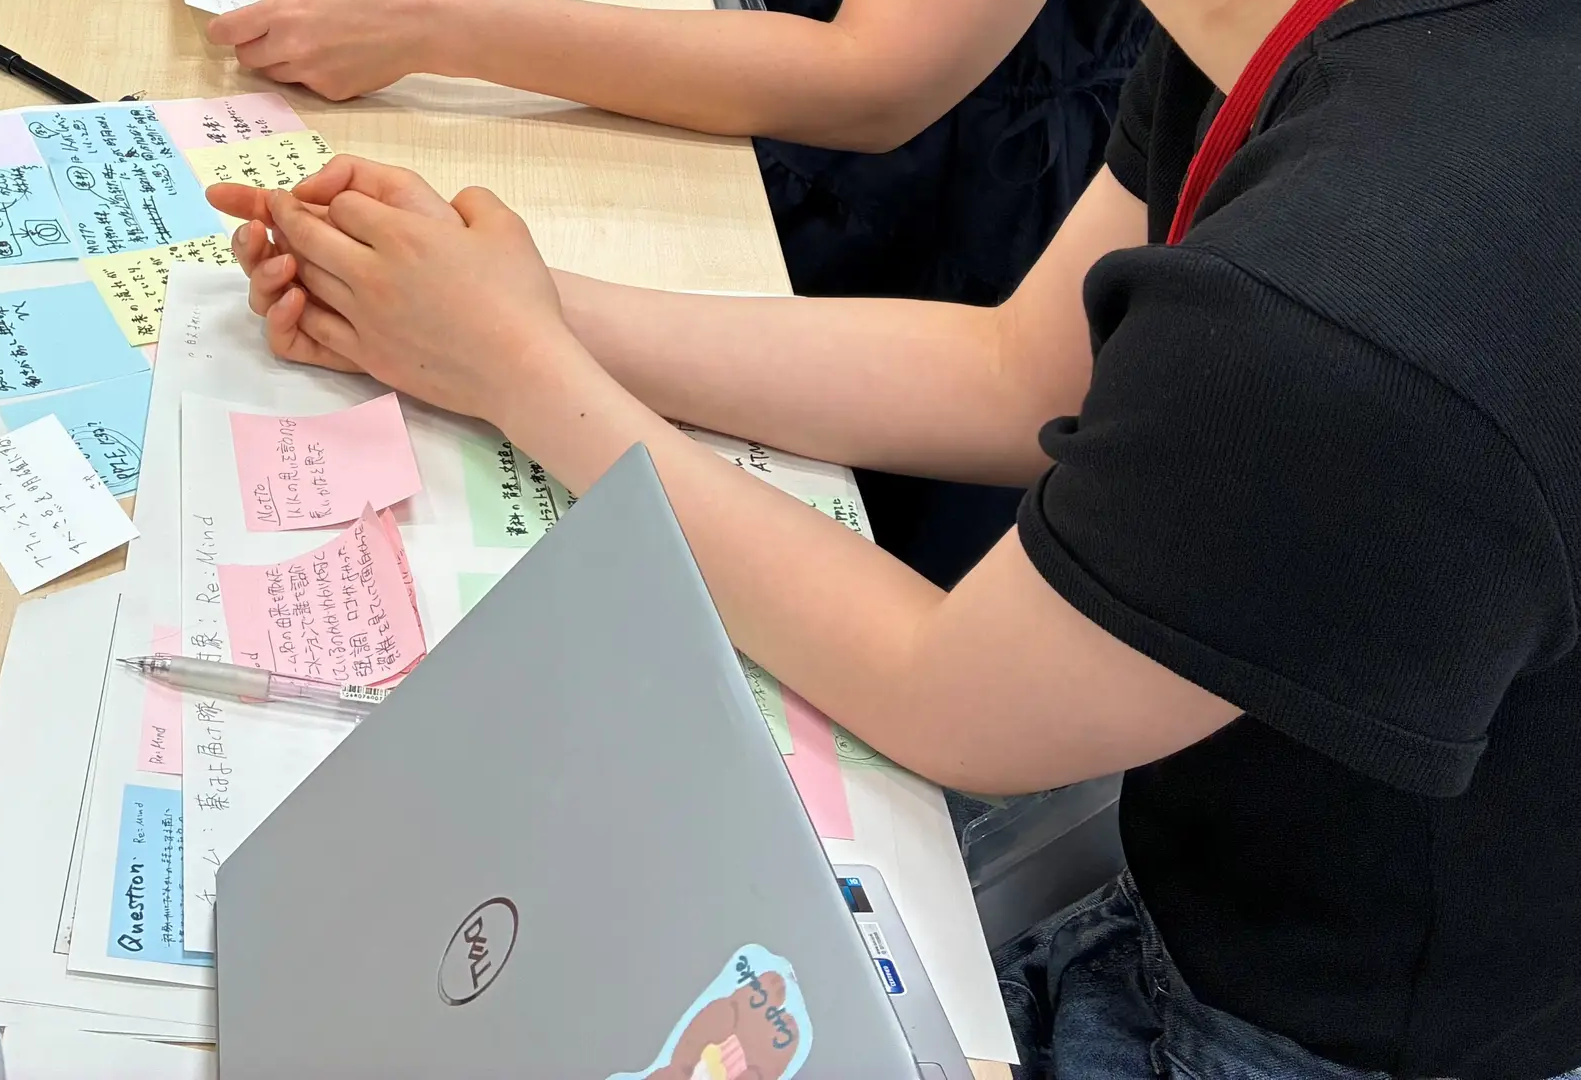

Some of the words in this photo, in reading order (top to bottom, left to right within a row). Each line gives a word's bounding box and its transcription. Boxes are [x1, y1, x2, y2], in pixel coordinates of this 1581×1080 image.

[461, 915, 494, 989] DELL
[735, 955, 767, 1009] Cake
[766, 1005, 793, 1050] Cup
